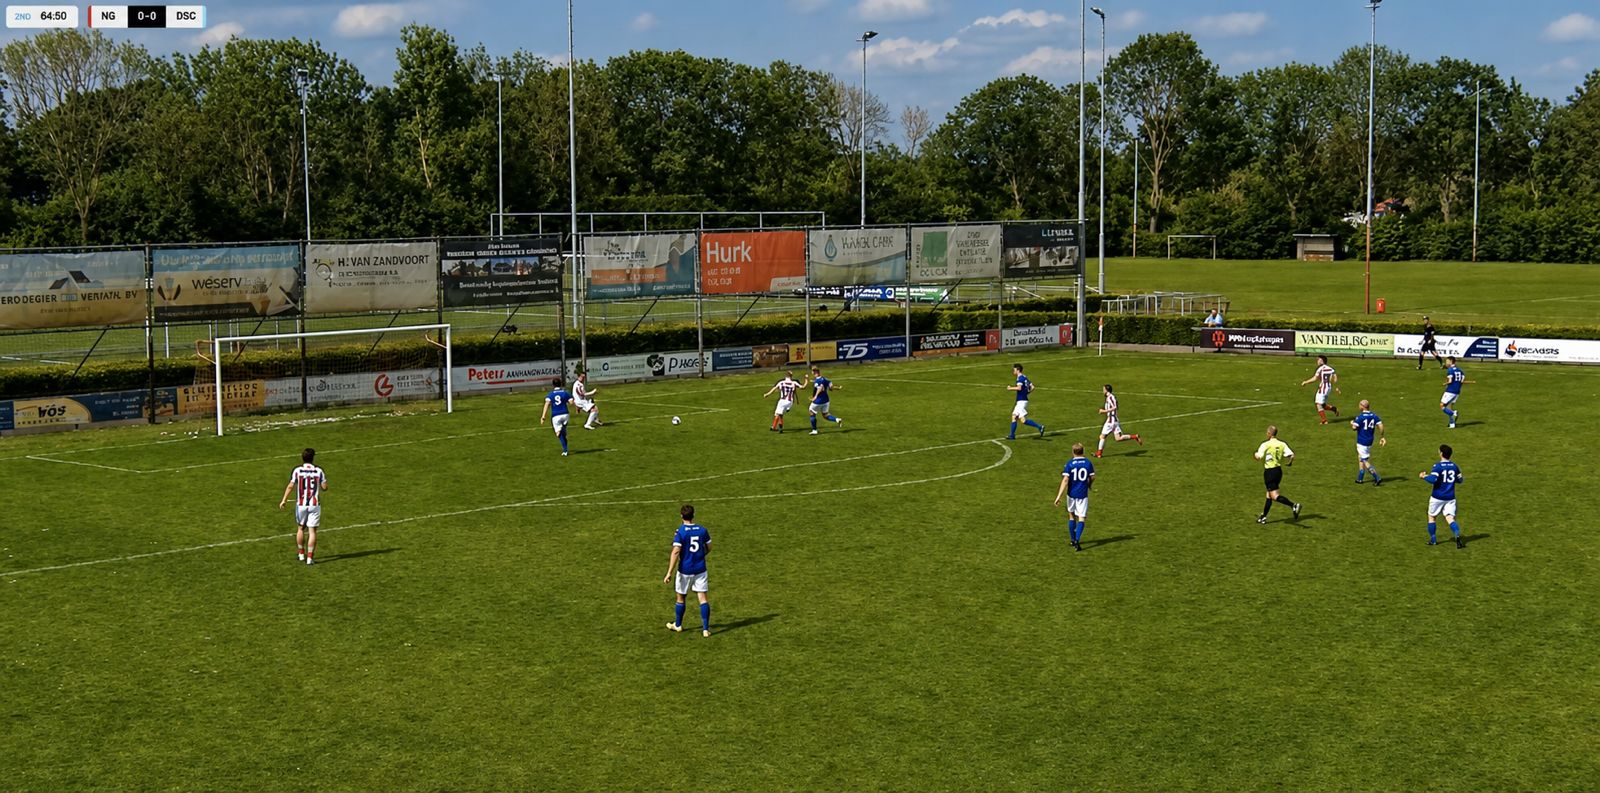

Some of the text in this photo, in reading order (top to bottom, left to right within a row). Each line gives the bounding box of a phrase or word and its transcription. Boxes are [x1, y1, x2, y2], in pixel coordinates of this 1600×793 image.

[706, 240, 752, 264] Hurk
[350, 256, 371, 266] VAN
[373, 254, 430, 267] ZANDVOORT
[1301, 334, 1324, 345] VAN
[468, 368, 505, 381] Peters
[554, 395, 562, 406] 9
[1362, 419, 1375, 430] 14
[1070, 467, 1088, 481] 10
[1441, 469, 1456, 483] 13
[689, 535, 700, 553] 5
